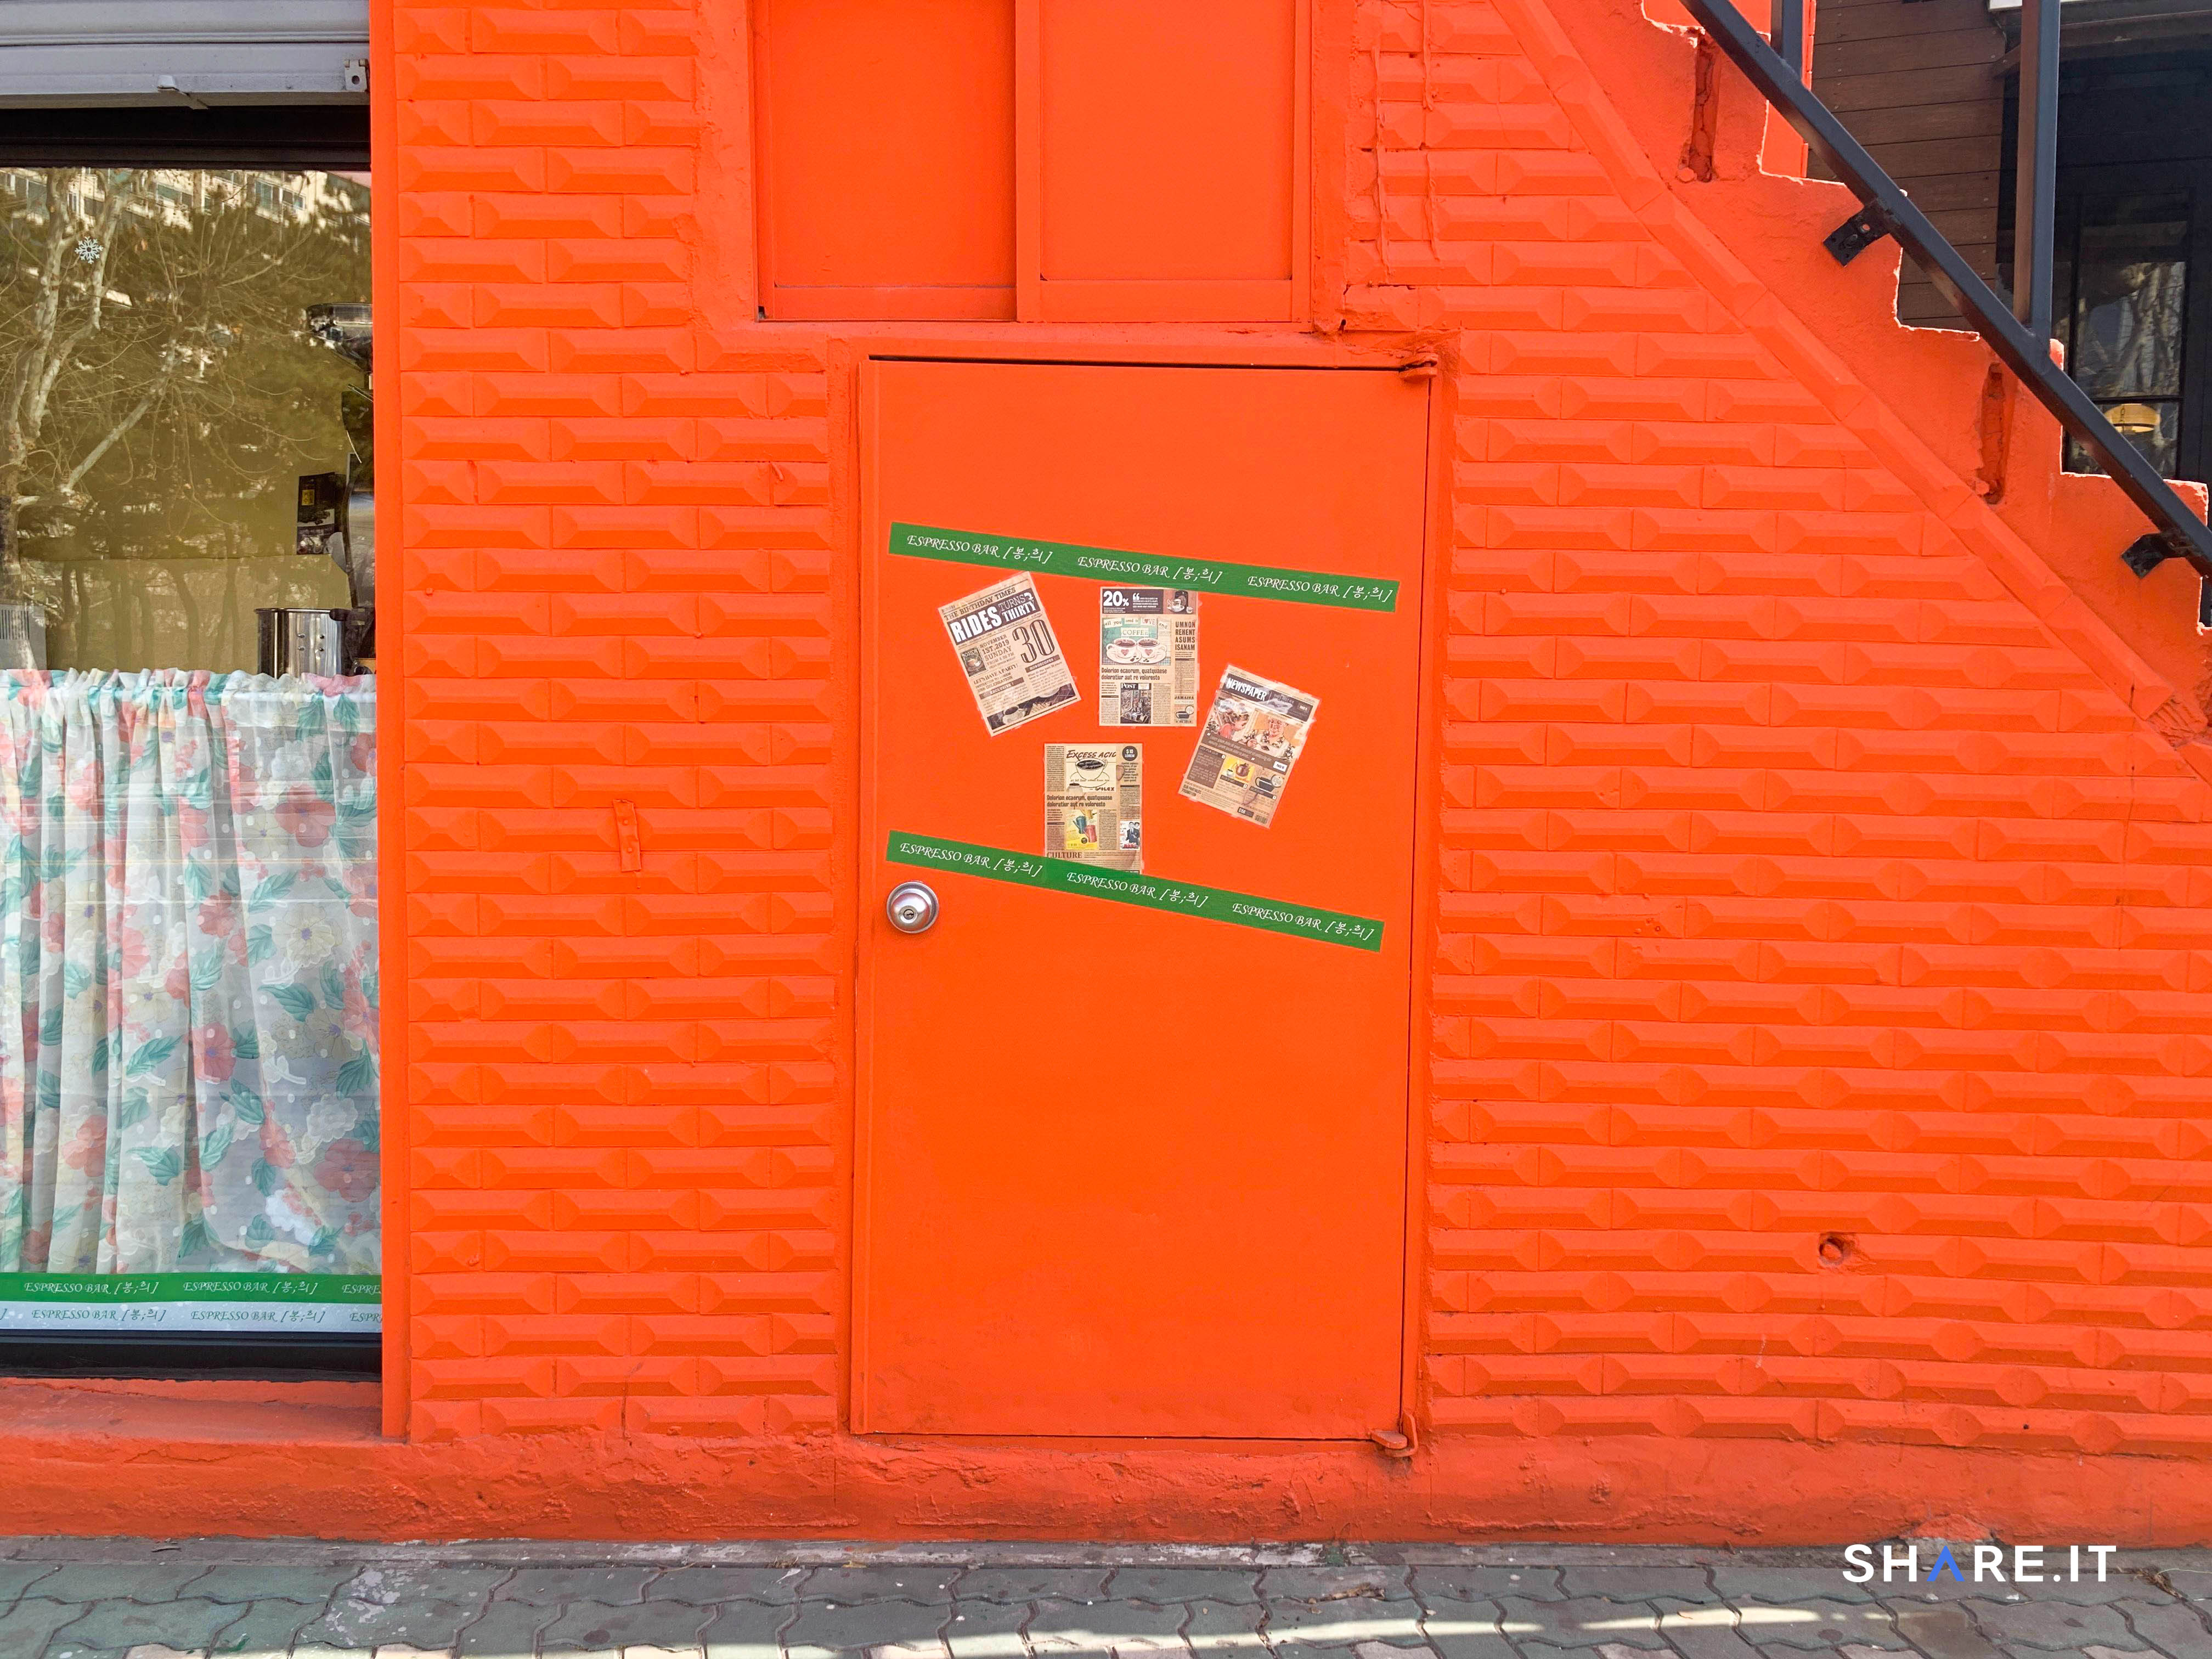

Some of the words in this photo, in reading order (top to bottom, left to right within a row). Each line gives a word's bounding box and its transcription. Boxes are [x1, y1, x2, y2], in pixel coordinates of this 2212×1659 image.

[907, 535, 970, 552] ESPRESSO
[972, 543, 1000, 558] BAR
[1077, 556, 1140, 572] ESPRESSO
[1142, 563, 1170, 578] BAR
[1248, 576, 1310, 591] ESPRESSO
[1312, 583, 1340, 597] BAR
[943, 610, 959, 621] THE
[958, 595, 995, 615] BIRTHDAY
[994, 586, 1017, 600] TIMES
[997, 594, 1026, 612] TURNS
[1103, 591, 1129, 606] 20%
[1001, 599, 1037, 622] THIRTY
[949, 605, 1003, 643] RIDES
[979, 633, 1007, 648] NOVEMBER
[1010, 617, 1057, 665] 30
[983, 645, 1012, 661] SUNDAY
[1225, 676, 1268, 701] NEWSPAPER
[1066, 750, 1098, 761] EXCESS
[900, 843, 961, 861] ESPRESSO
[963, 853, 991, 868] BAR
[1066, 872, 1128, 891] ESPRESSO
[1130, 884, 1156, 899] BAR
[1232, 903, 1293, 922] ESPRESSO
[1295, 916, 1322, 931] BAR
[24, 1282, 82, 1293] ESPRESSO
[84, 1283, 111, 1294] BAR
[183, 1282, 241, 1292] ESPRESSO
[243, 1282, 270, 1293] BAR
[32, 1310, 89, 1319] ESPRESSO
[92, 1310, 121, 1321] BAR
[191, 1310, 249, 1321] ESPRESSO
[251, 1310, 278, 1322] BAR
